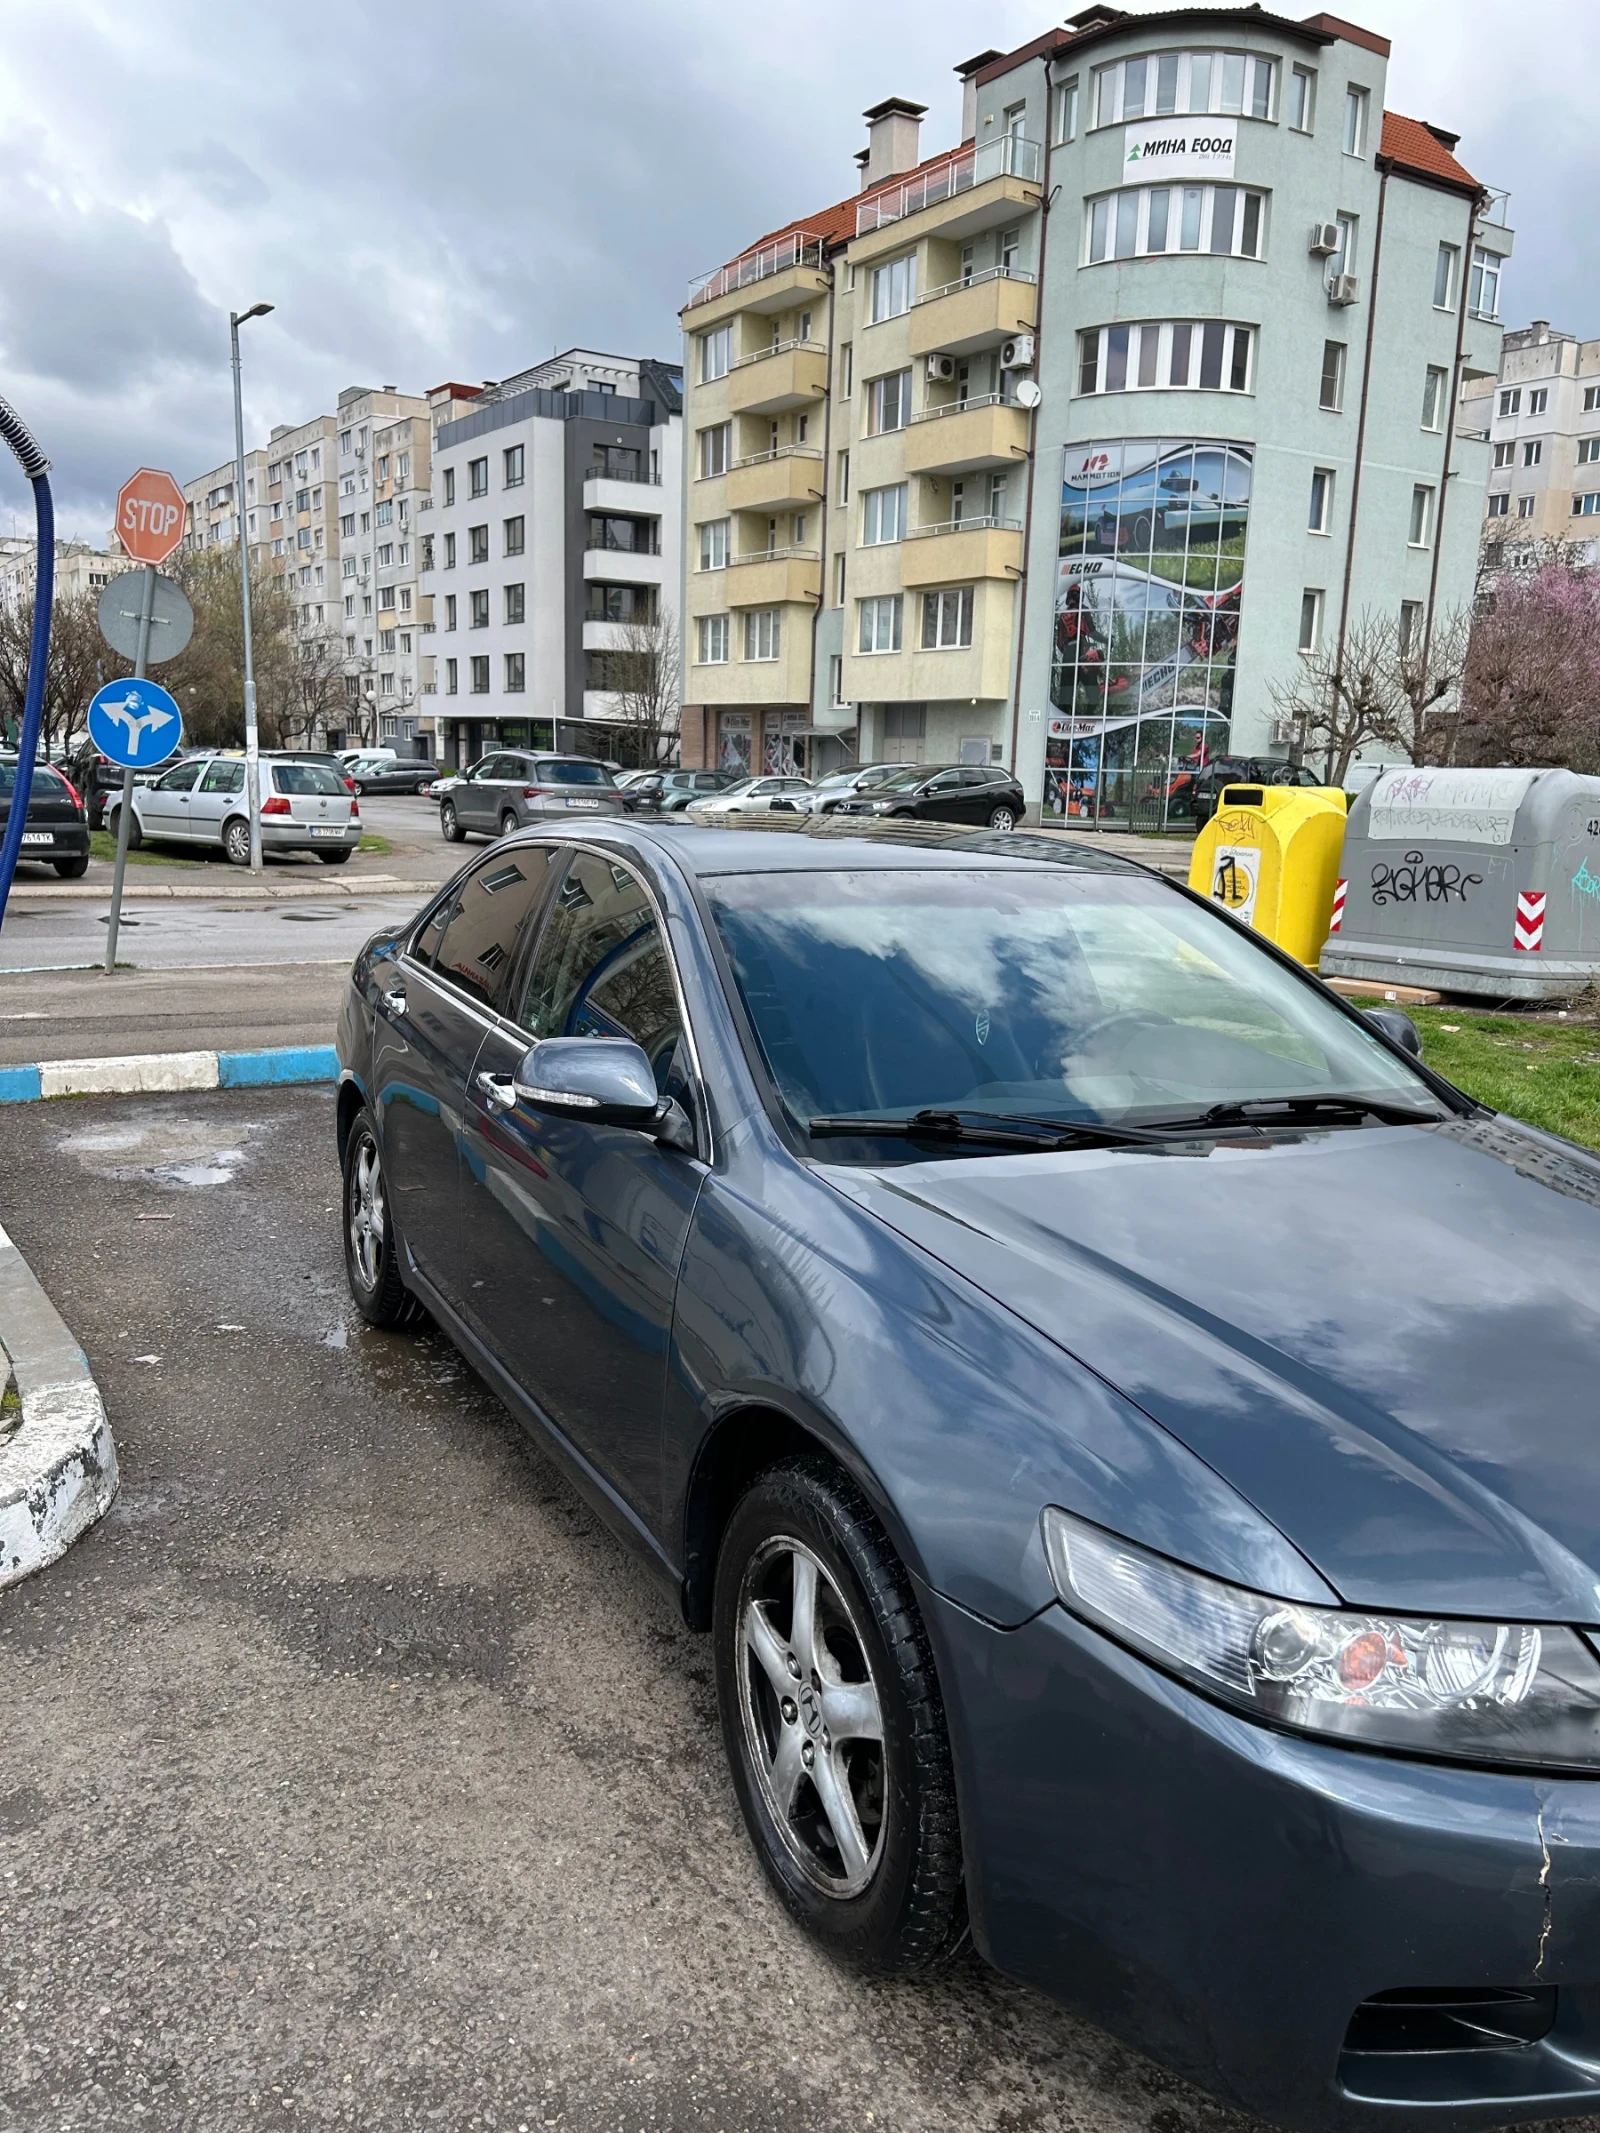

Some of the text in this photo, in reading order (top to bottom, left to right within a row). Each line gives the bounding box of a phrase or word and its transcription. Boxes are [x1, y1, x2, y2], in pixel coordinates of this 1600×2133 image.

[1143, 138, 1232, 157] МИНА ЕООД
[123, 497, 179, 536] STOP
[1069, 562, 1103, 575] ECHO
[41, 833, 52, 842] TK
